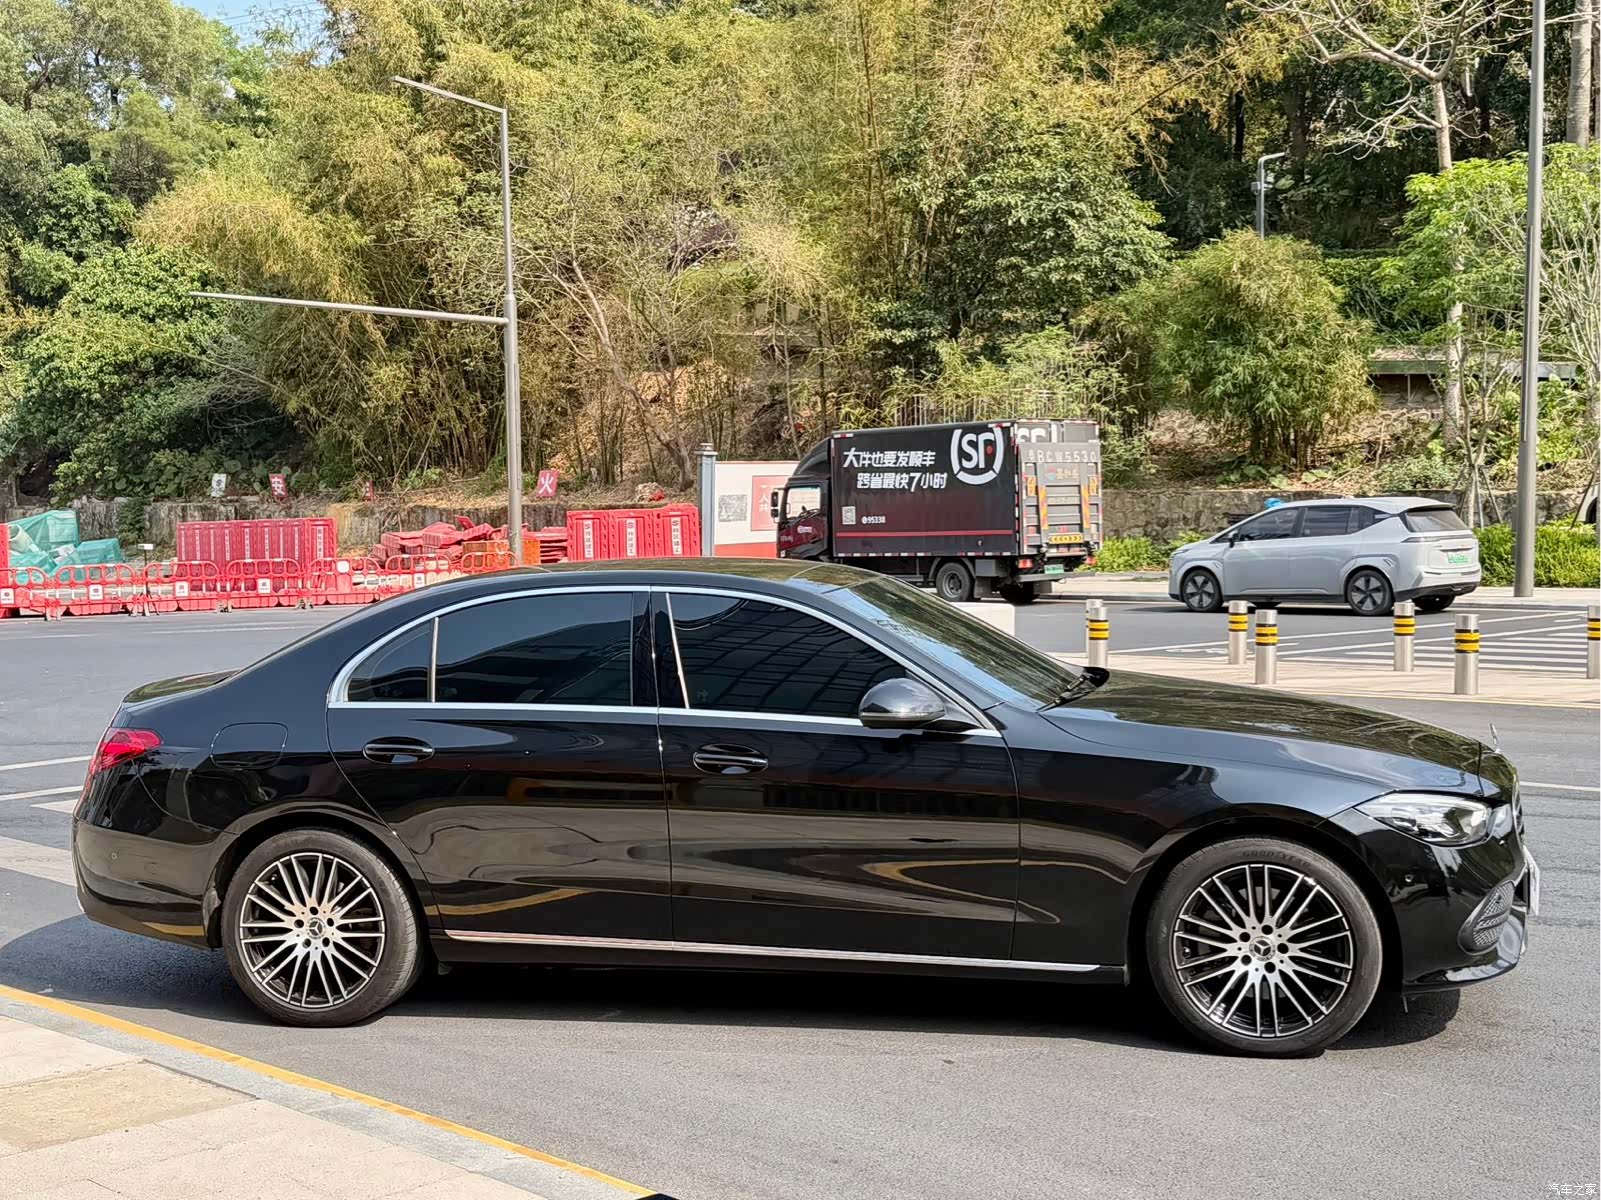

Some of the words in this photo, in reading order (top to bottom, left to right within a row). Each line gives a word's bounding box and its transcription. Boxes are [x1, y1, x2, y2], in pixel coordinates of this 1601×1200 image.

[843, 447, 936, 468] 大件也要发顺丰
[270, 476, 285, 496] 安
[537, 472, 555, 494] 火
[857, 472, 948, 492] 跨省最快7小时
[867, 516, 886, 524] 95338
